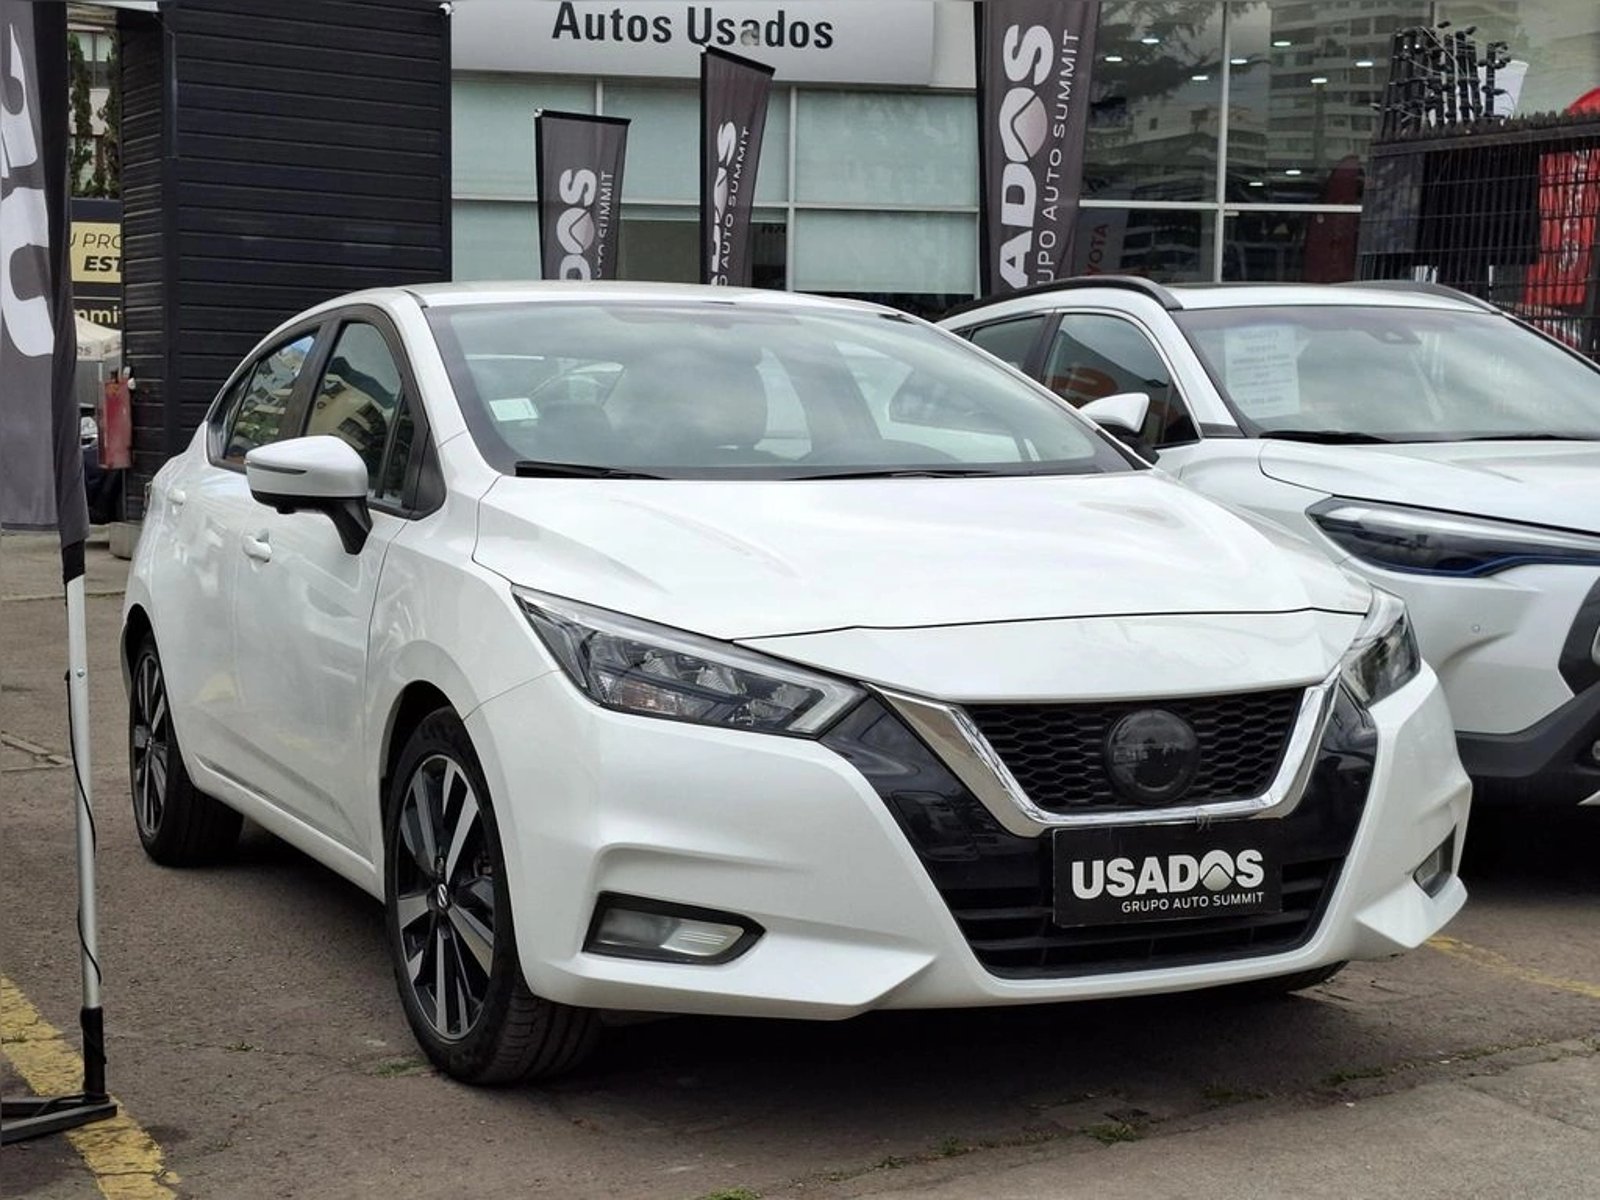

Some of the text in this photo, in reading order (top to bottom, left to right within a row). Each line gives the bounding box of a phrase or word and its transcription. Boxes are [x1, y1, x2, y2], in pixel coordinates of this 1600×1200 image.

[552, 1, 834, 49] Autos Usados
[1042, 148, 1062, 221] AUTO
[1053, 29, 1079, 138] SUMMIT
[721, 213, 734, 268] AUTO
[728, 126, 750, 207] SUMMIT
[1072, 849, 1265, 900] USADOS
[1121, 891, 1265, 914] GRUPO AUTO SUMMIT
